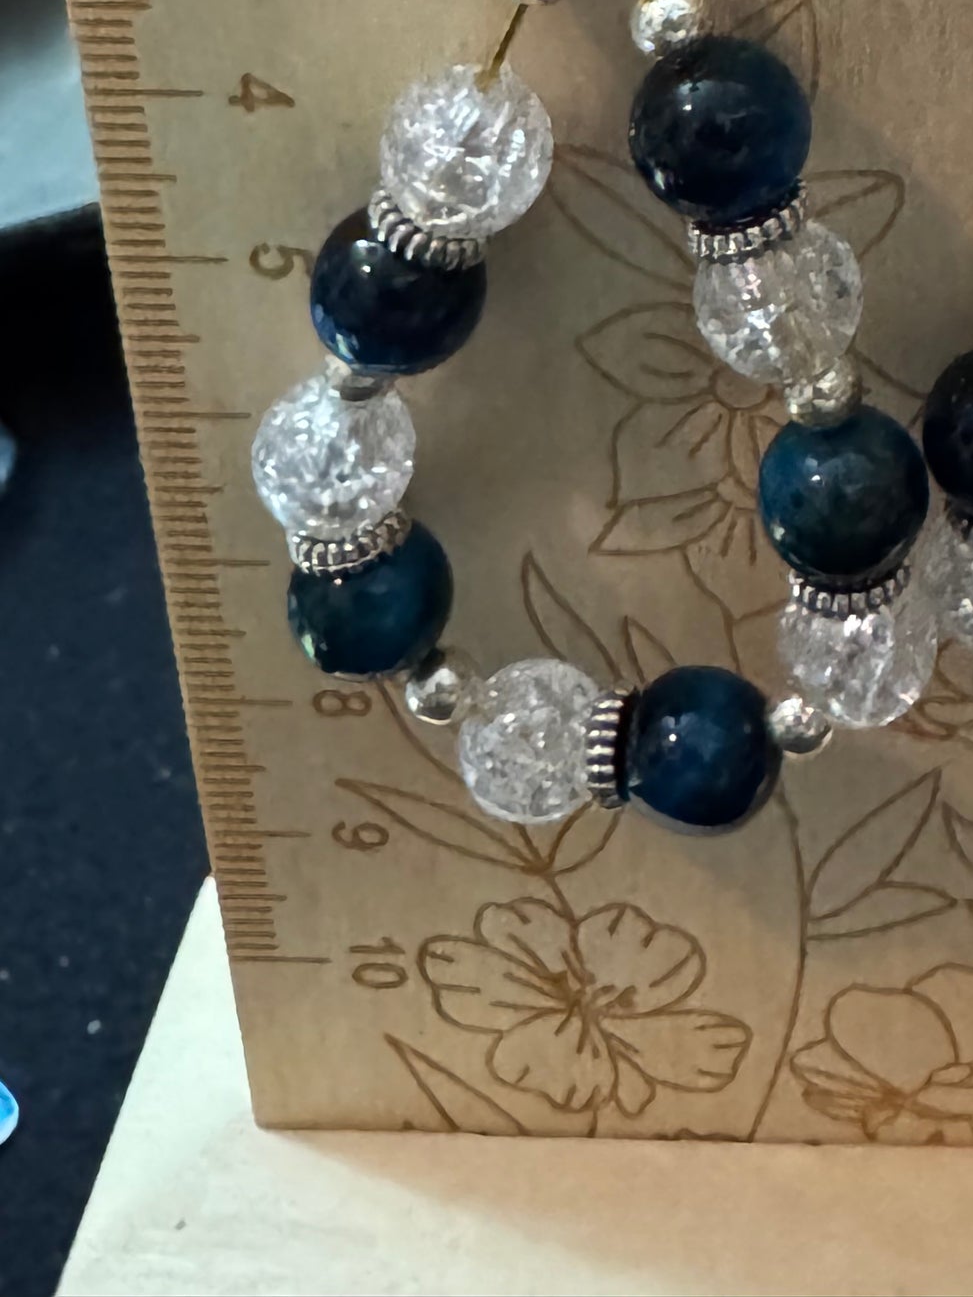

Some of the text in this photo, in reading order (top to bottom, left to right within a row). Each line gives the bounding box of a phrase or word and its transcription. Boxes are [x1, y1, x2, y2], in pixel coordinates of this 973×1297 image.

[228, 72, 296, 113] 4
[248, 242, 317, 281] 5
[313, 689, 373, 718] 8
[331, 821, 390, 851] 9
[349, 936, 409, 990] 10
